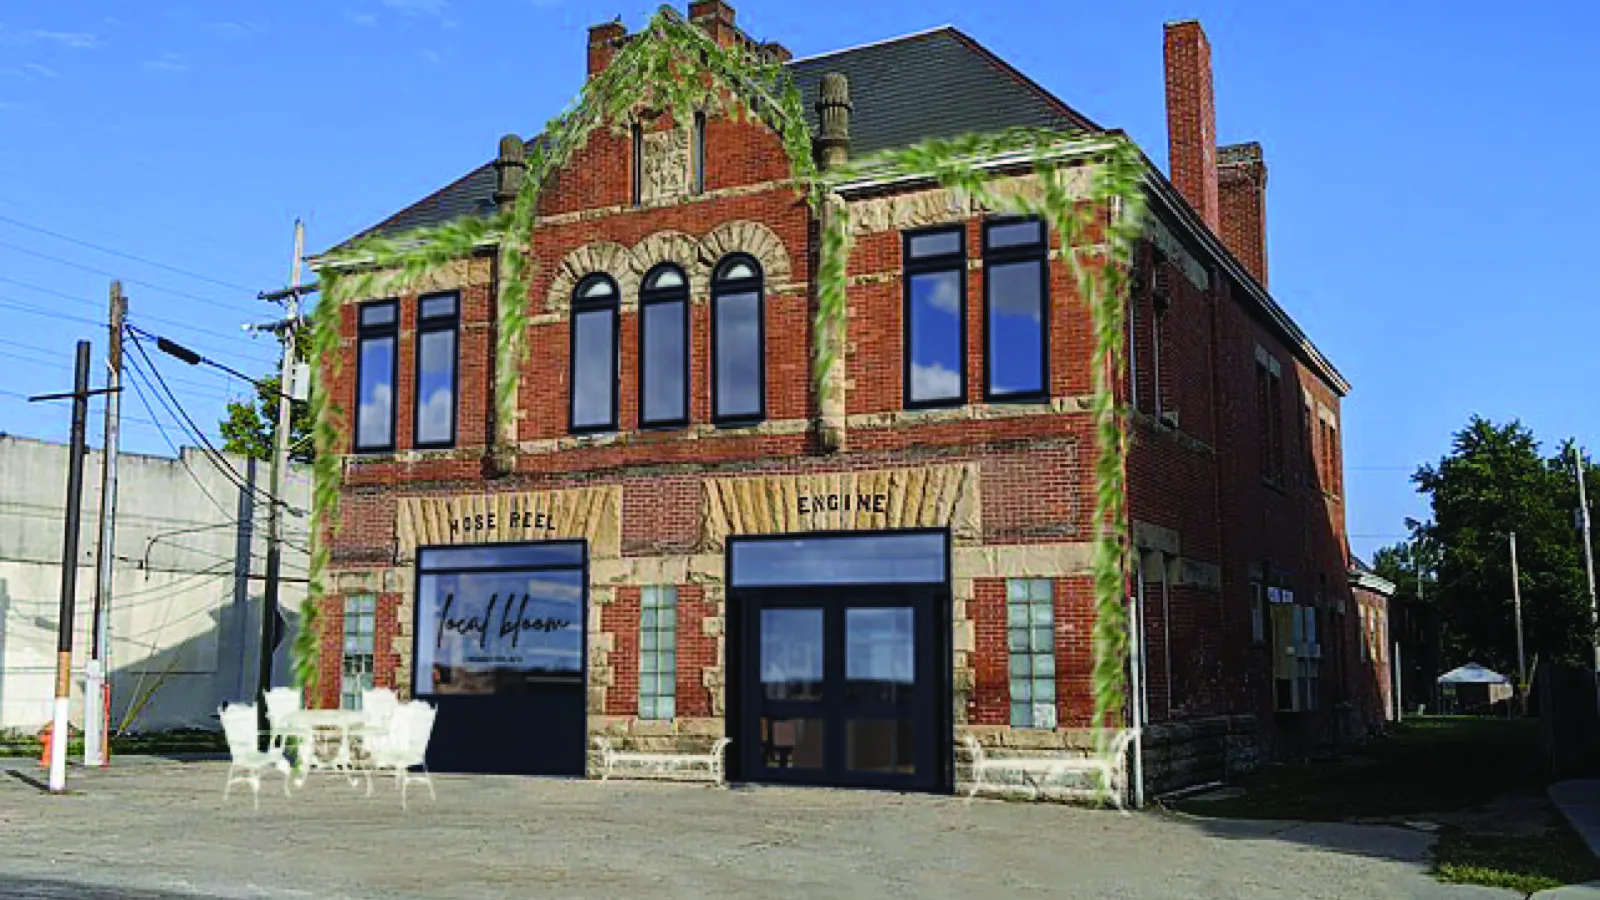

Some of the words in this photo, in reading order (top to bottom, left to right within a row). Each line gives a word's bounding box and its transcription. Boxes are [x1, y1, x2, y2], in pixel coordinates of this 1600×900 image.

[799, 494, 887, 513] ENGINE
[450, 514, 496, 534] HOSE
[509, 511, 556, 530] REEL
[437, 593, 498, 648] local
[500, 592, 571, 648] bloom
